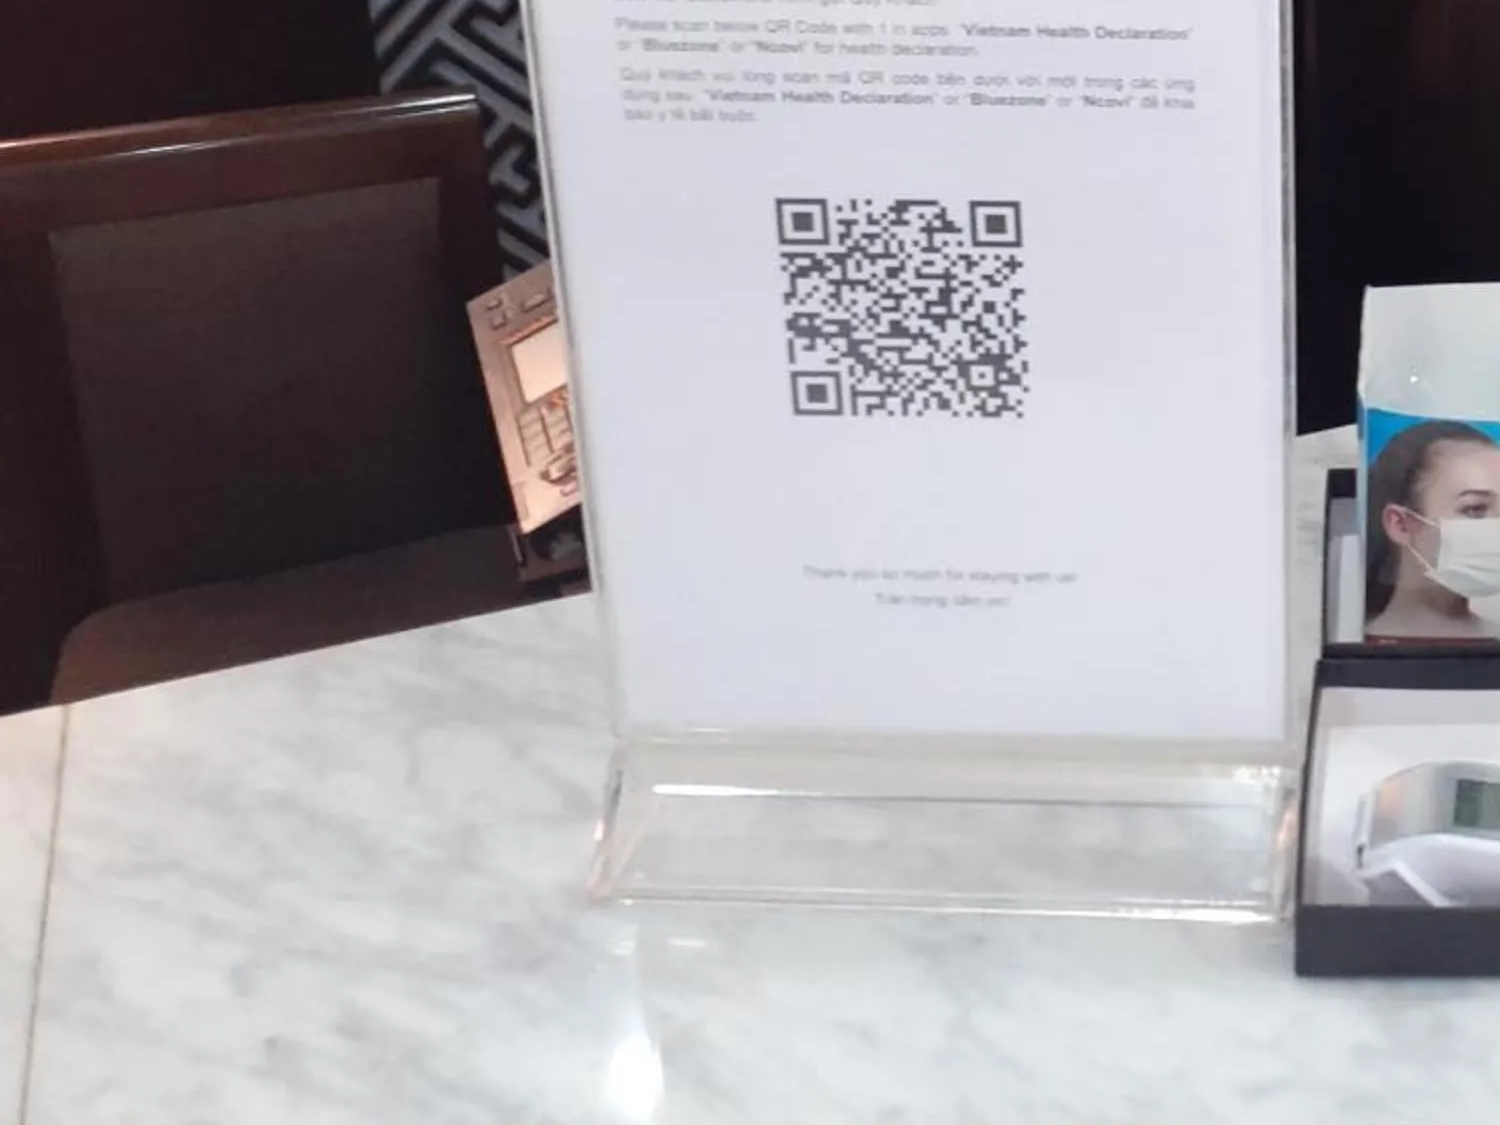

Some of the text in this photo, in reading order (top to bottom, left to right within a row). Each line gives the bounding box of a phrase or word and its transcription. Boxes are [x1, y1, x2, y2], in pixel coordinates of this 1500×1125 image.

[614, 17, 668, 32] Please
[673, 21, 709, 33] scan
[714, 20, 759, 33] below
[765, 20, 790, 34] QR
[795, 20, 837, 34] Code
[1036, 24, 1091, 38] Health
[814, 41, 835, 55] for
[839, 42, 887, 56] health
[857, 70, 885, 85] QR
[892, 74, 929, 86] code
[781, 90, 835, 104] Health
